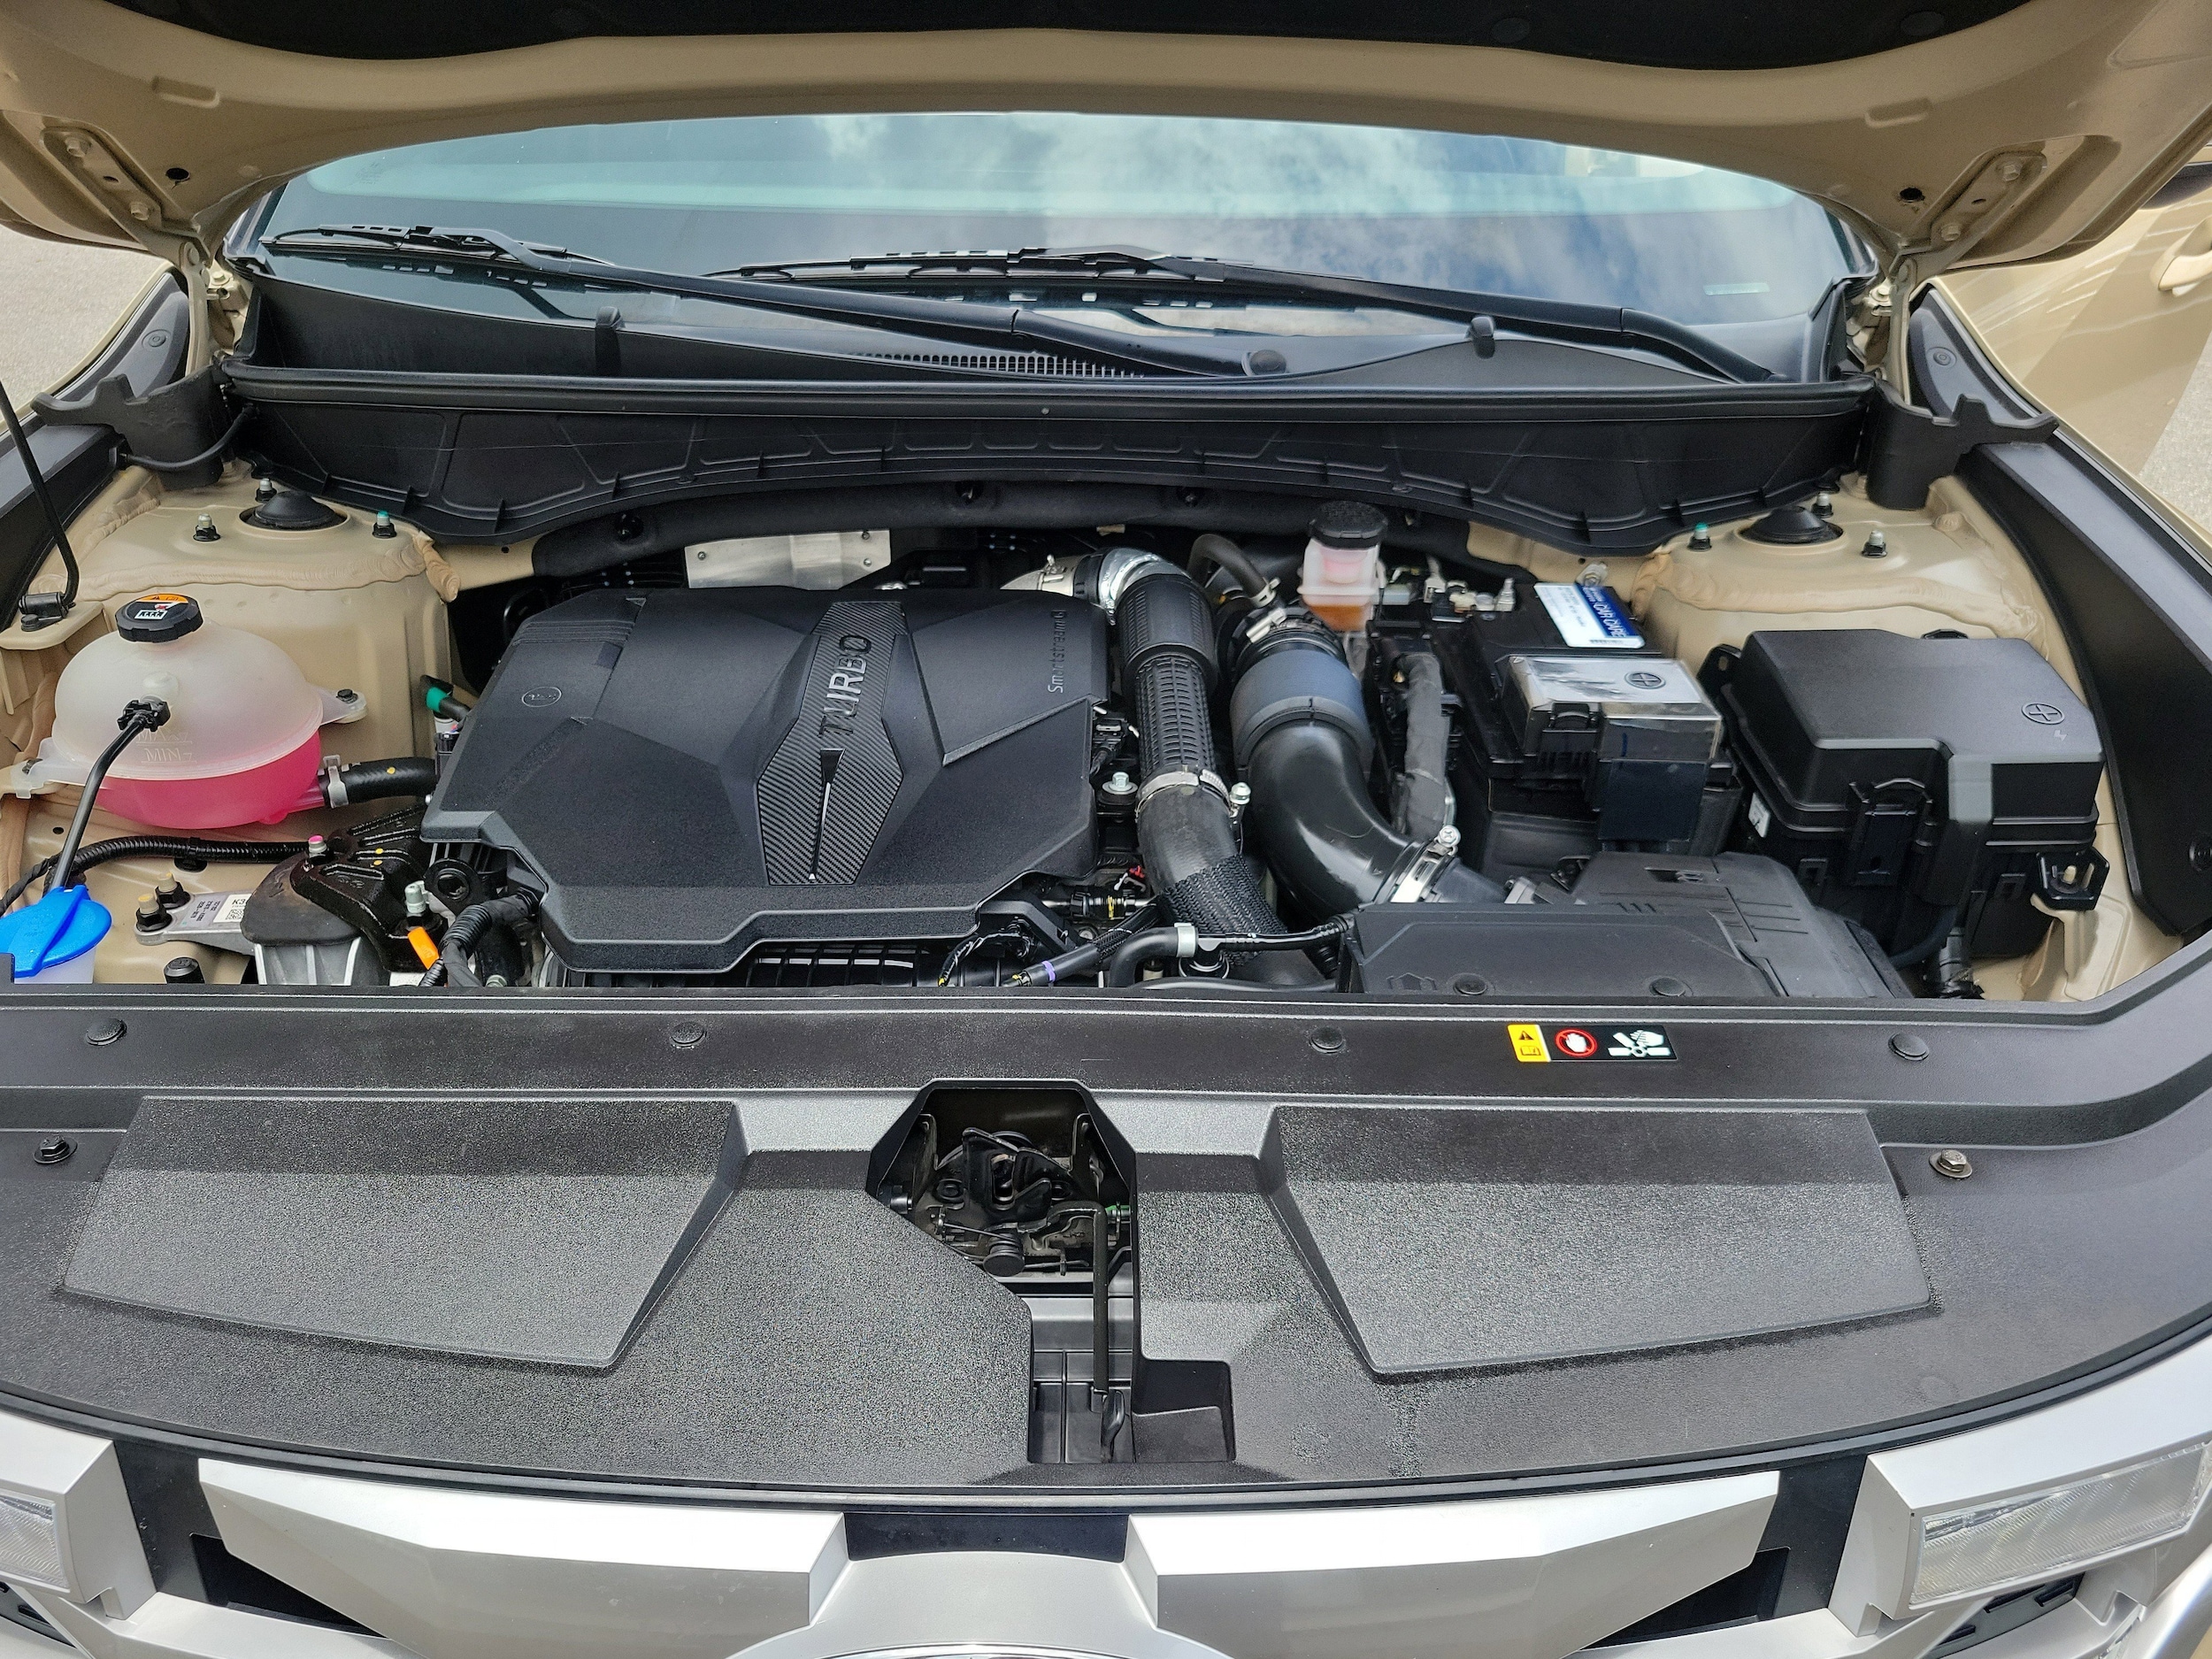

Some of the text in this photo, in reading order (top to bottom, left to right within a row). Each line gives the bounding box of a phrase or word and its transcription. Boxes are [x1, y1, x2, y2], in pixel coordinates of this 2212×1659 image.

[1593, 602, 1617, 618] CAR
[1603, 618, 1627, 638] CARE
[1048, 620, 1066, 694] Smartstream
[817, 635, 872, 738] TURBO
[143, 748, 182, 761] MIN
